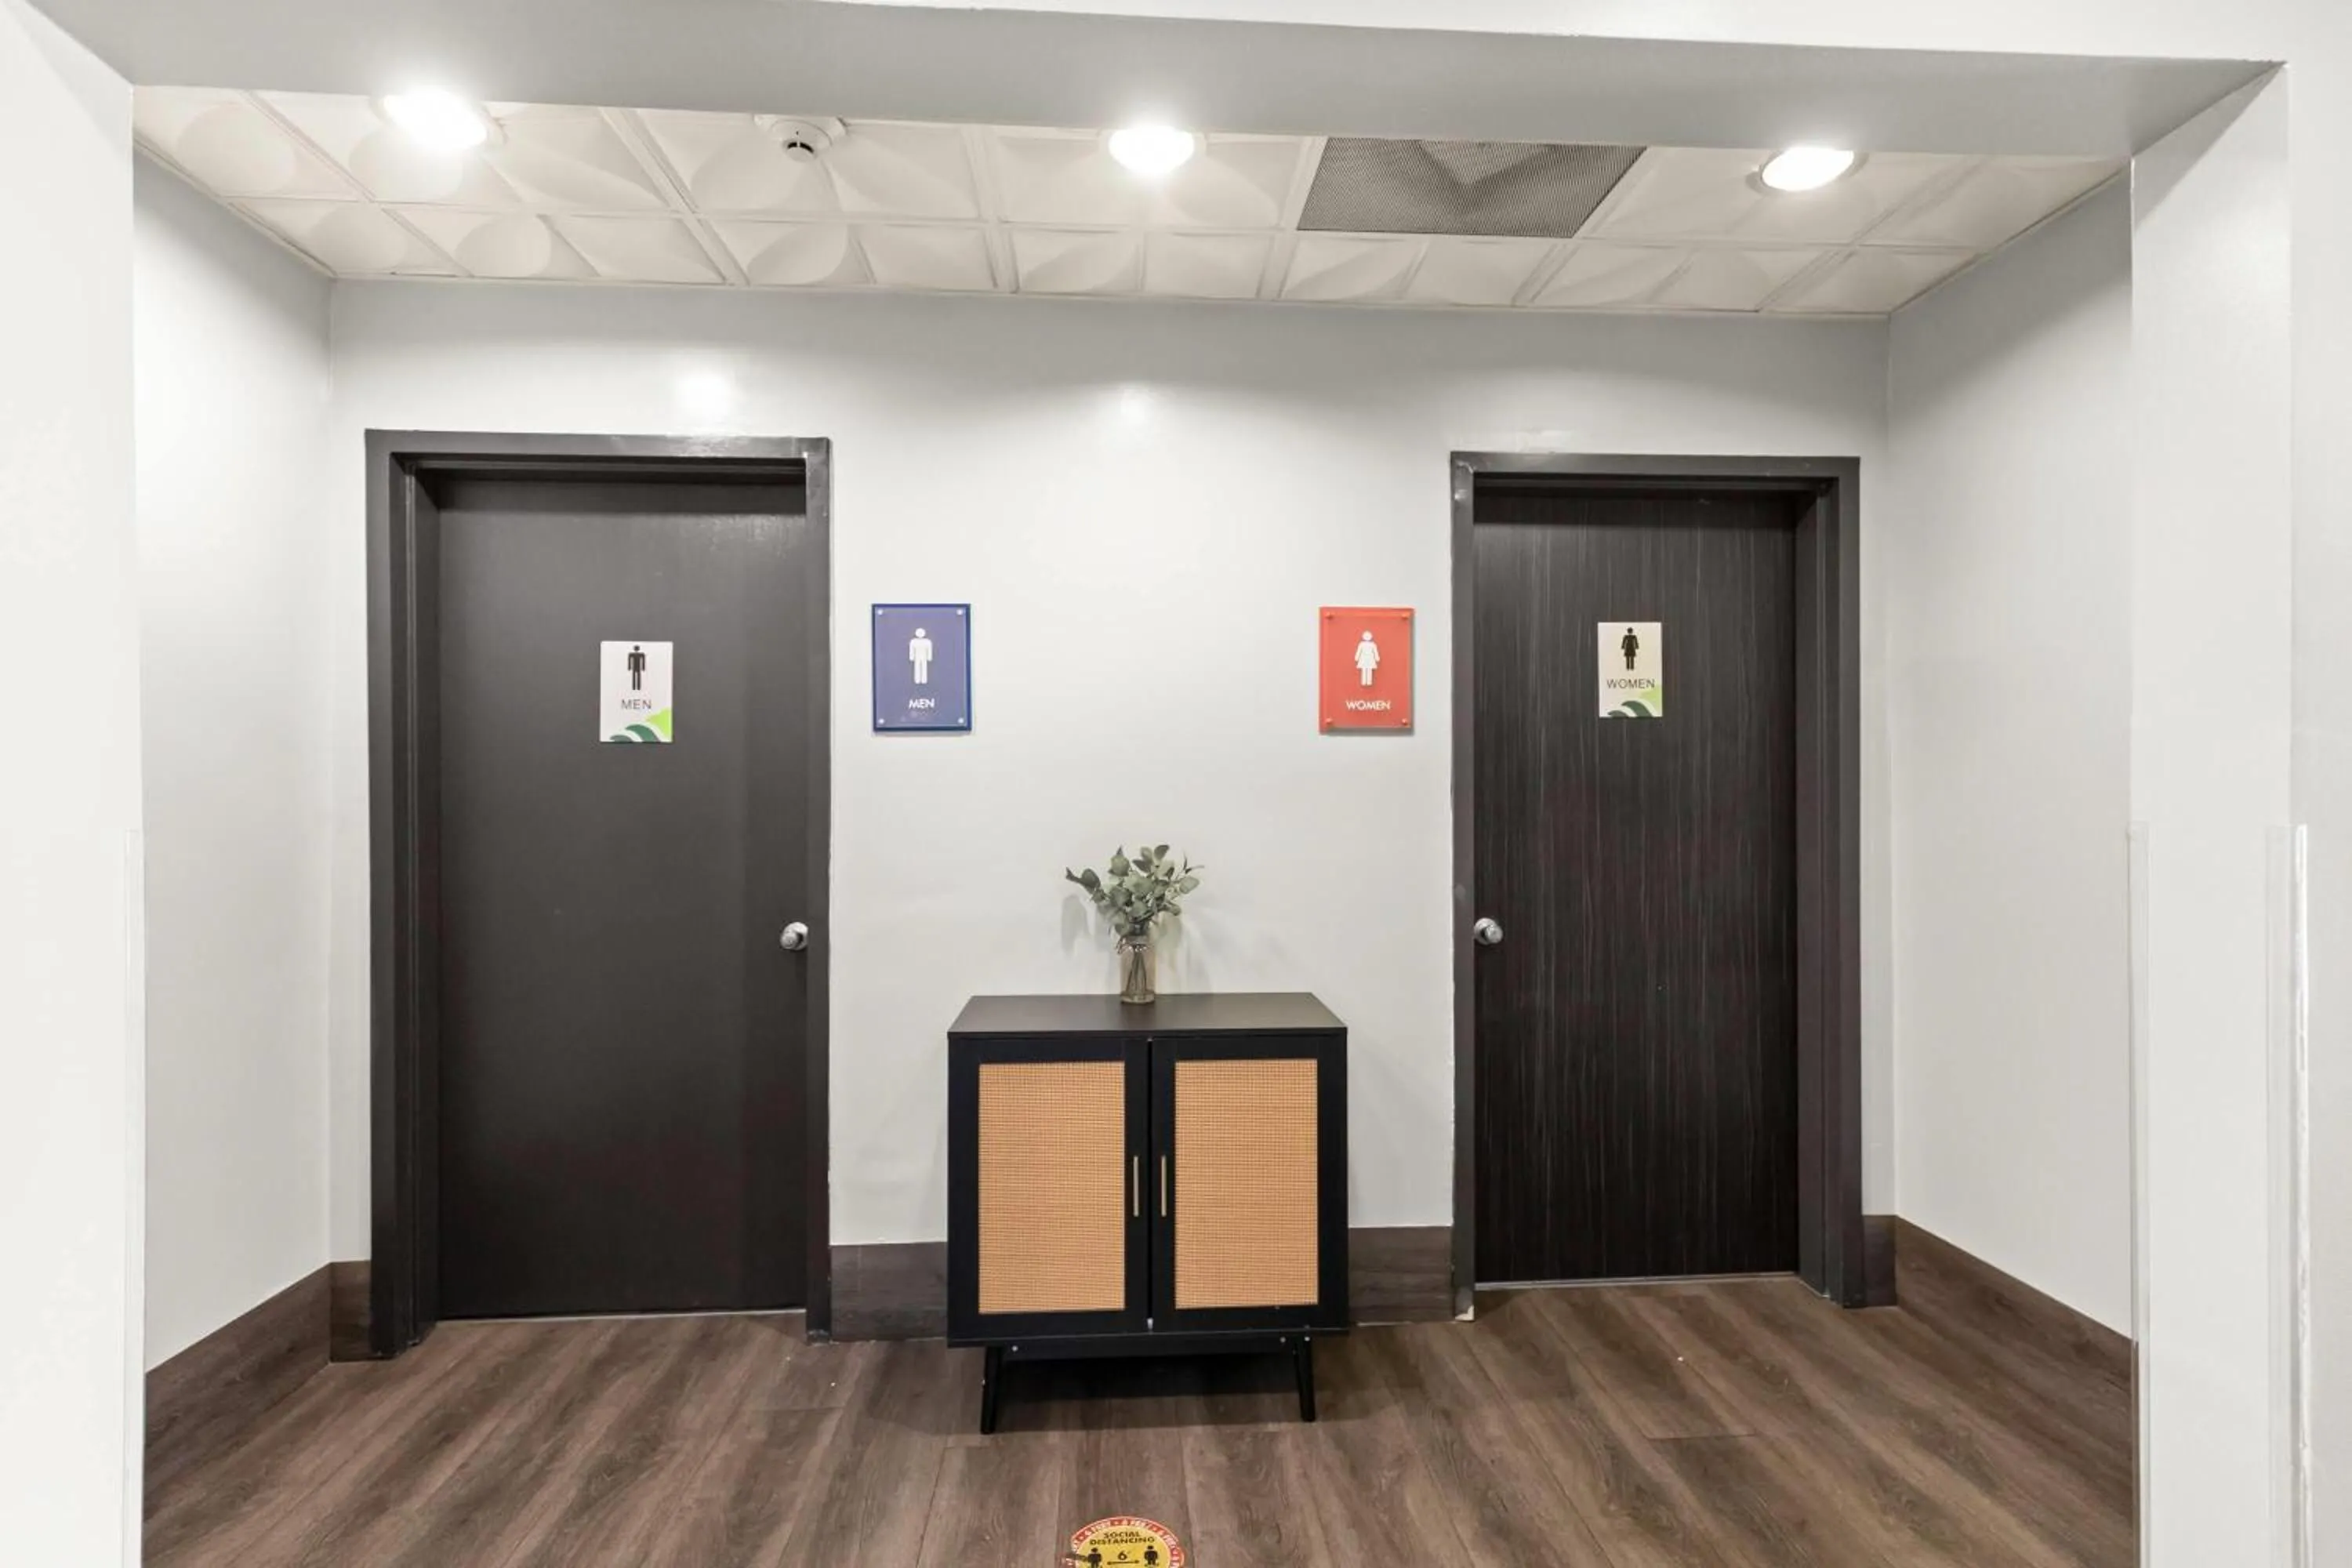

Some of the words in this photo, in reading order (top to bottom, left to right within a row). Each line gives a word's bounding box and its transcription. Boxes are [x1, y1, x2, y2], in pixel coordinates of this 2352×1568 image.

[1606, 678, 1655, 689] WOMEN
[621, 699, 652, 710] MEN
[909, 698, 935, 710] MEN
[1345, 699, 1391, 711] WOMEN
[1103, 1531, 1142, 1540] SOCIAL
[1090, 1537, 1156, 1546] DISTANCING
